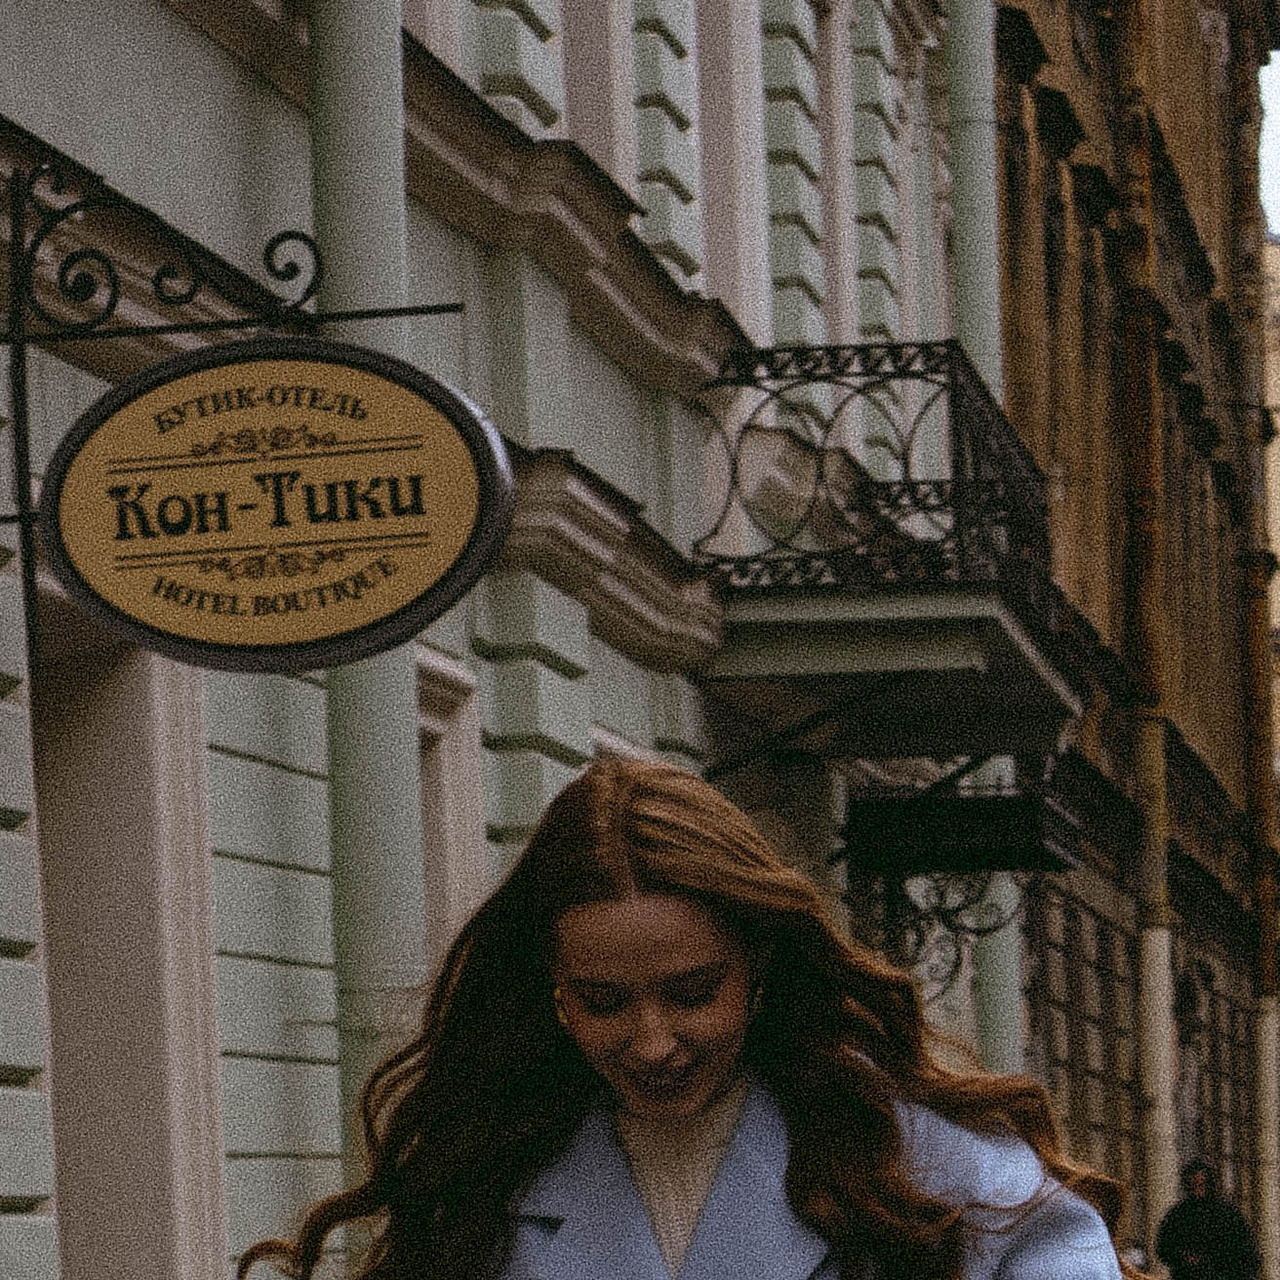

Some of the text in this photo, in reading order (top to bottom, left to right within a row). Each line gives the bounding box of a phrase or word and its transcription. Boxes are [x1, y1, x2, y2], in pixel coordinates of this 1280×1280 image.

[153, 384, 369, 434] БУТИК-ОТЕЛЬ
[106, 470, 426, 541] Кон-Тики
[152, 554, 399, 616] HOTEL BOUTIQUE
